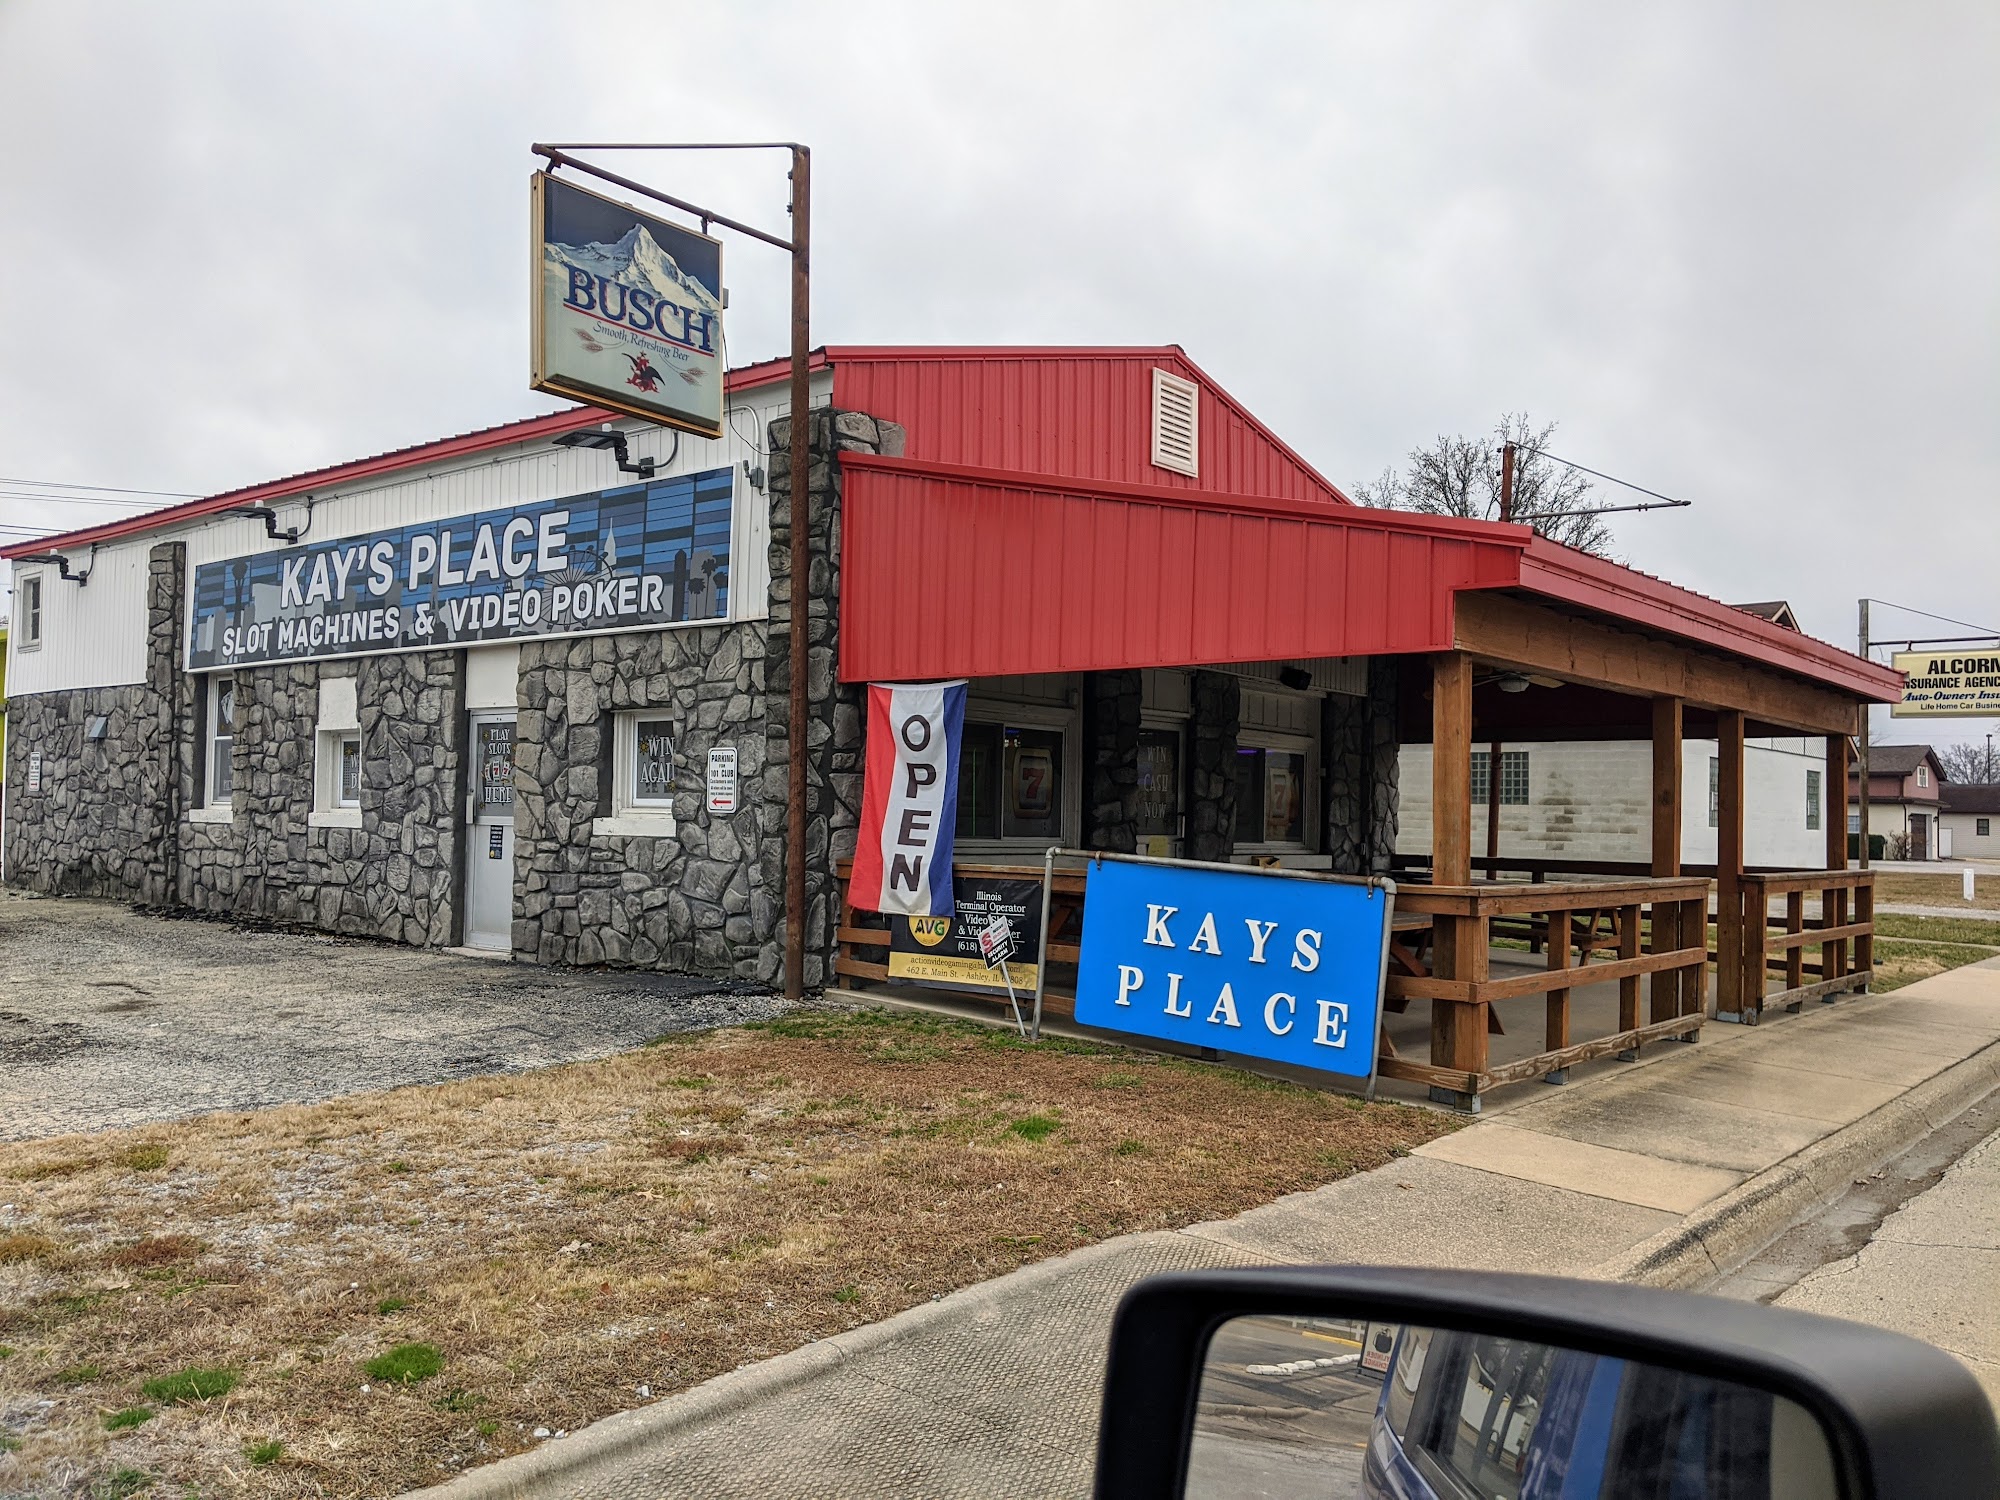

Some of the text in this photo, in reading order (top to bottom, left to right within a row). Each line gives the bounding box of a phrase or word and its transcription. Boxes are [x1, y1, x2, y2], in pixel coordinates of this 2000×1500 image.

[563, 263, 715, 353] BUSCH
[630, 332, 671, 358] Refreshing
[671, 346, 690, 361] Beer
[280, 510, 570, 608] KAY'S PLACE
[222, 574, 665, 657] SLOT MACHINES & VIDEO POKER
[1927, 658, 2000, 675] ALCORN
[1902, 676, 2000, 689] NSURANCE AGENC
[1902, 691, 1976, 701] Auto-Owners
[490, 728, 510, 741] PLAY
[488, 743, 511, 754] SLOTS
[648, 736, 675, 758] WIN
[1147, 745, 1167, 763] WIN
[1023, 768, 1045, 799] 7
[1143, 773, 1169, 792] CASH
[484, 786, 512, 803] HERE
[889, 714, 937, 892] OPEN
[1144, 801, 1168, 818] NOW
[976, 890, 1002, 902] Illinois
[955, 900, 1026, 914] Terminal Operator
[965, 913, 988, 924] Video
[915, 919, 944, 936] AVG
[958, 925, 965, 935] &
[967, 926, 983, 936] Vid
[1143, 903, 1323, 972] KAYS
[957, 941, 977, 953] (618)
[906, 966, 920, 974] 462
[930, 968, 948, 977] Main
[949, 970, 959, 978] St.
[966, 971, 991, 983] Ashley,
[1001, 974, 1024, 984] 6808
[1114, 964, 1350, 1049] PLACE
